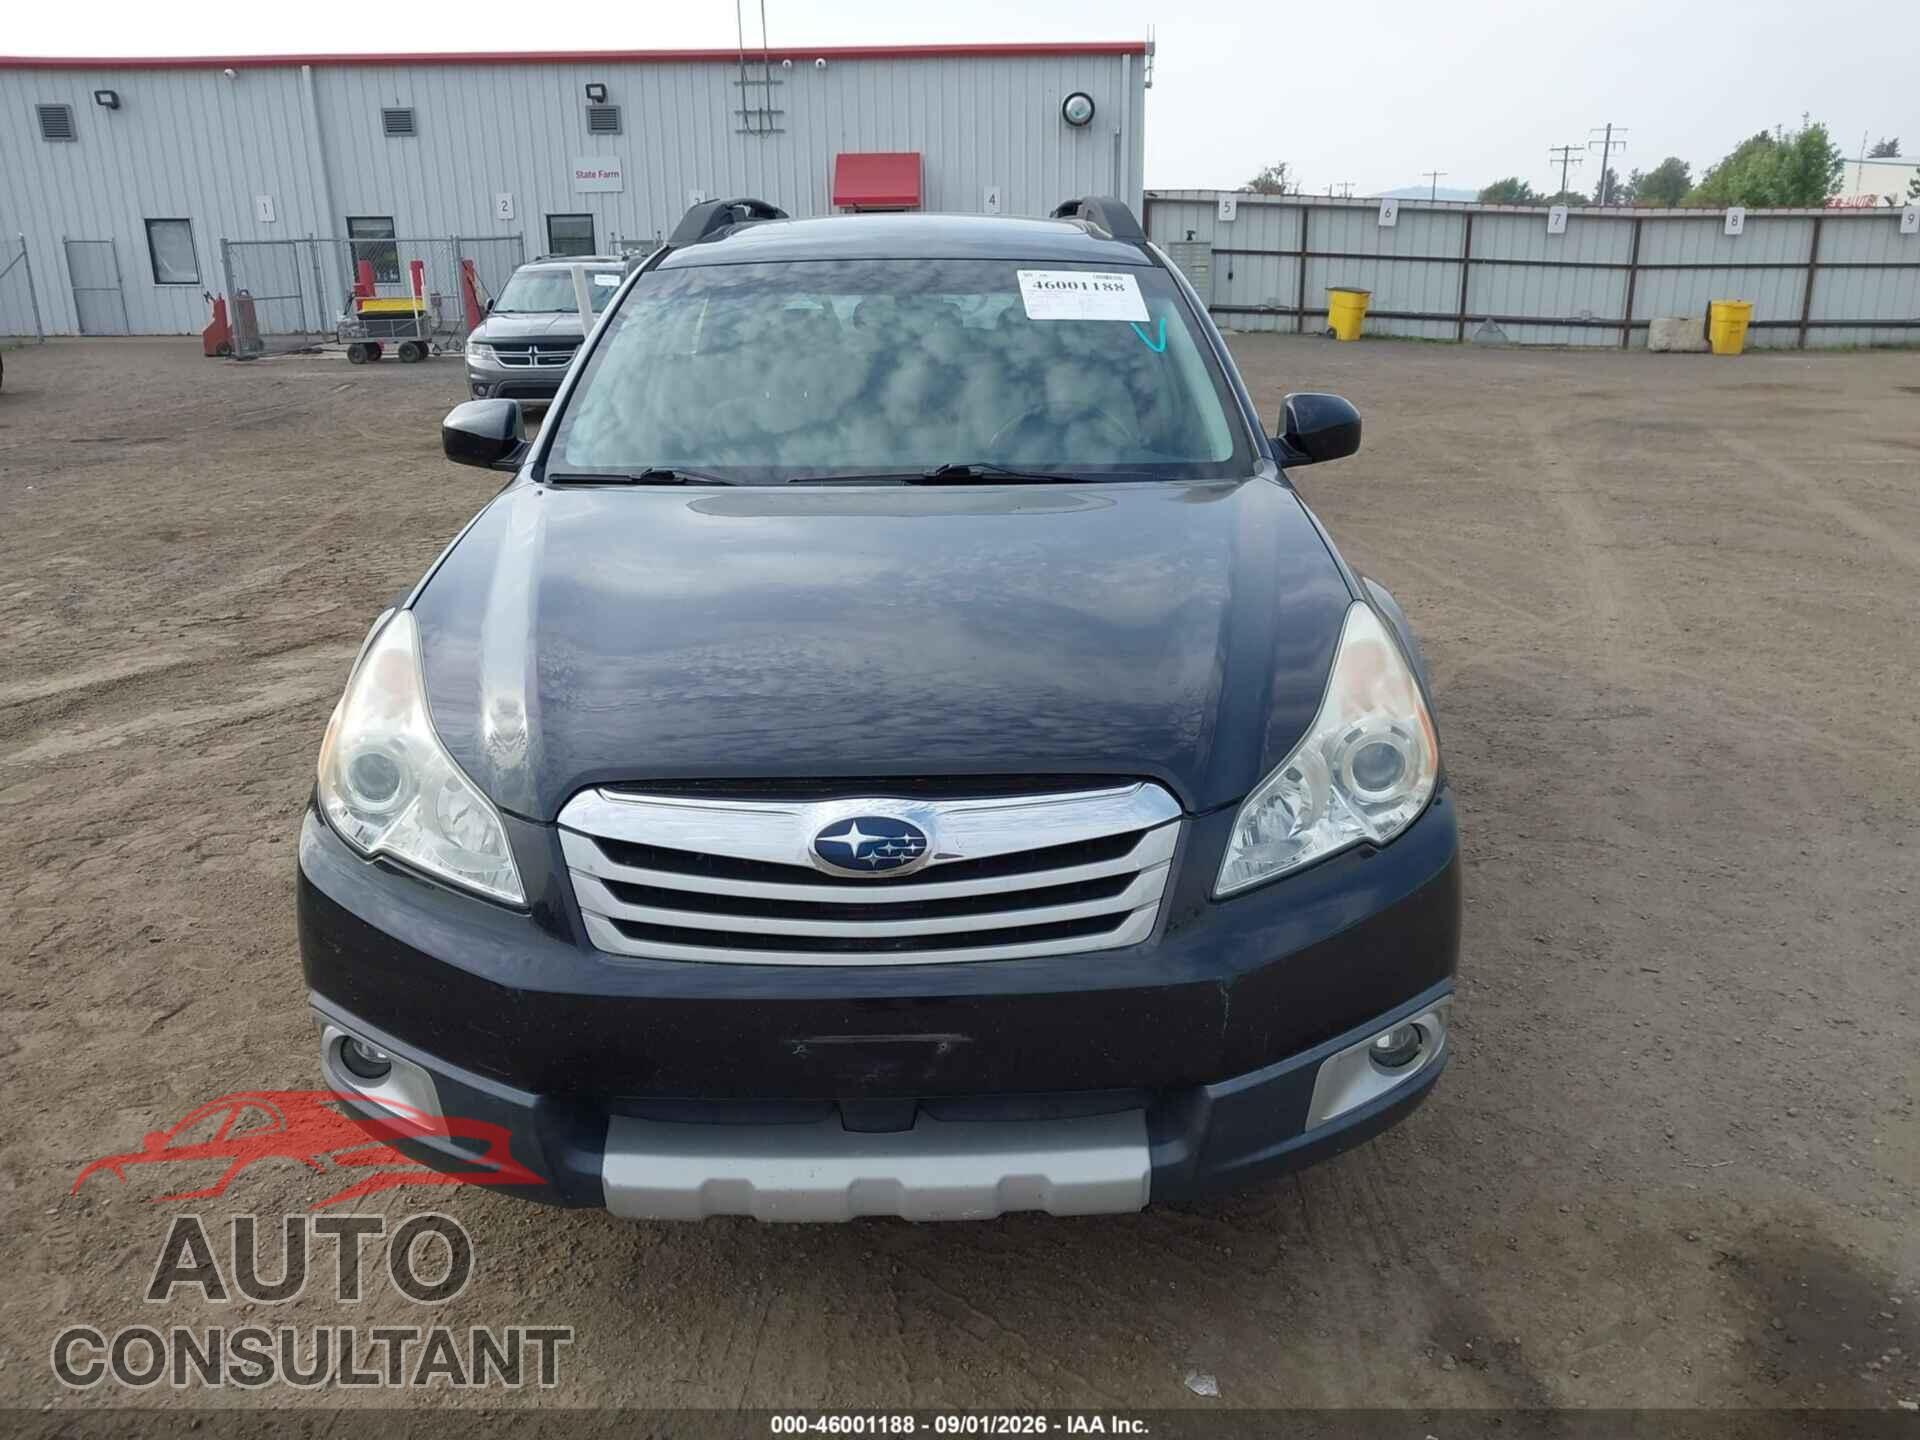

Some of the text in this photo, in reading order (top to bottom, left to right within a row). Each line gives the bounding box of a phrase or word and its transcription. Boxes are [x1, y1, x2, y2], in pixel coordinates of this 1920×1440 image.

[575, 169, 620, 179] State Farm
[988, 193, 996, 206] 4
[501, 200, 509, 212] 2
[1223, 200, 1232, 213] 5
[1384, 207, 1392, 218] 6
[1552, 213, 1562, 225] 7
[1731, 215, 1739, 226] 8
[1907, 213, 1916, 225] 9
[1032, 280, 1126, 292] 46001188
